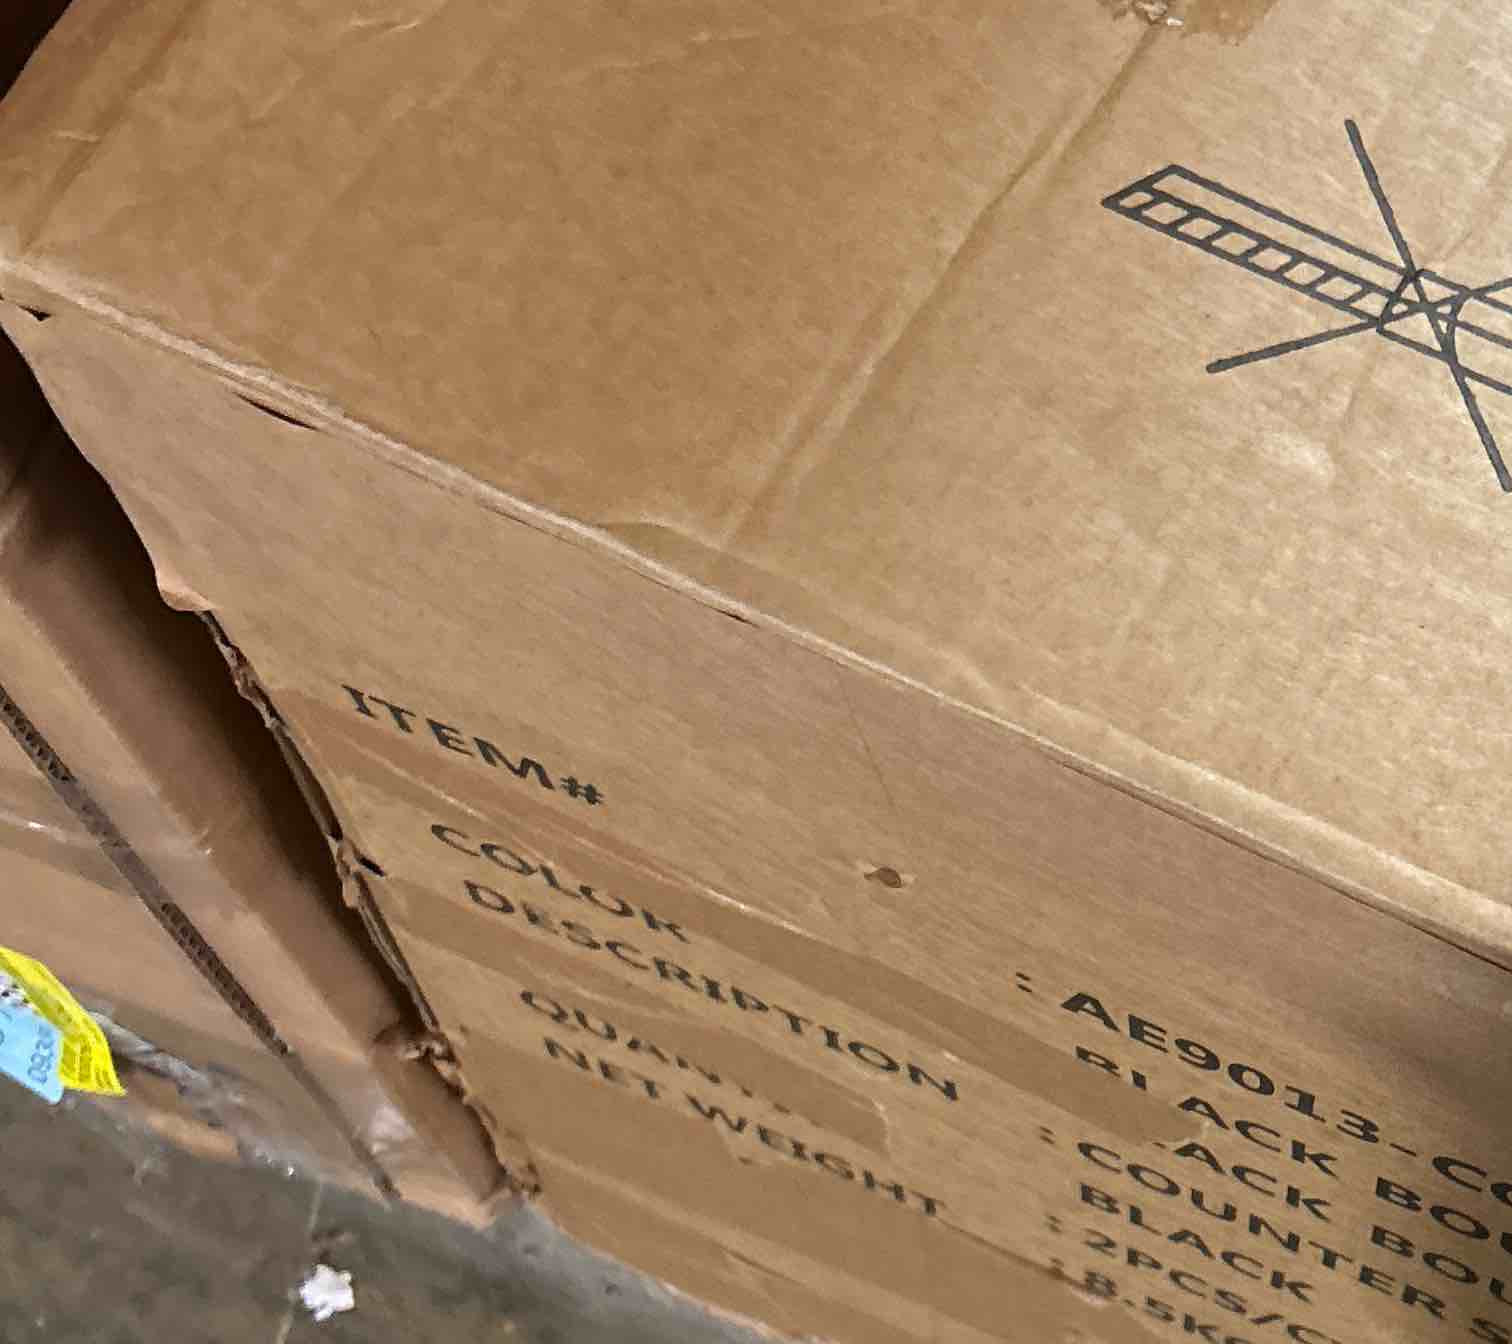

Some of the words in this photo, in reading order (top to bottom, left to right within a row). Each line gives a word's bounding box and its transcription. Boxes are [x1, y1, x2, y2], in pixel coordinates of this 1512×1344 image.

[340, 682, 606, 807] ITEM#
[463, 879, 961, 1102] DESCRIPTION
[542, 1036, 662, 1100] NET
[684, 1091, 947, 1216] WEIGHT
[1076, 1141, 1448, 1321] COUNTER
[1078, 1181, 1315, 1305] BLACK
